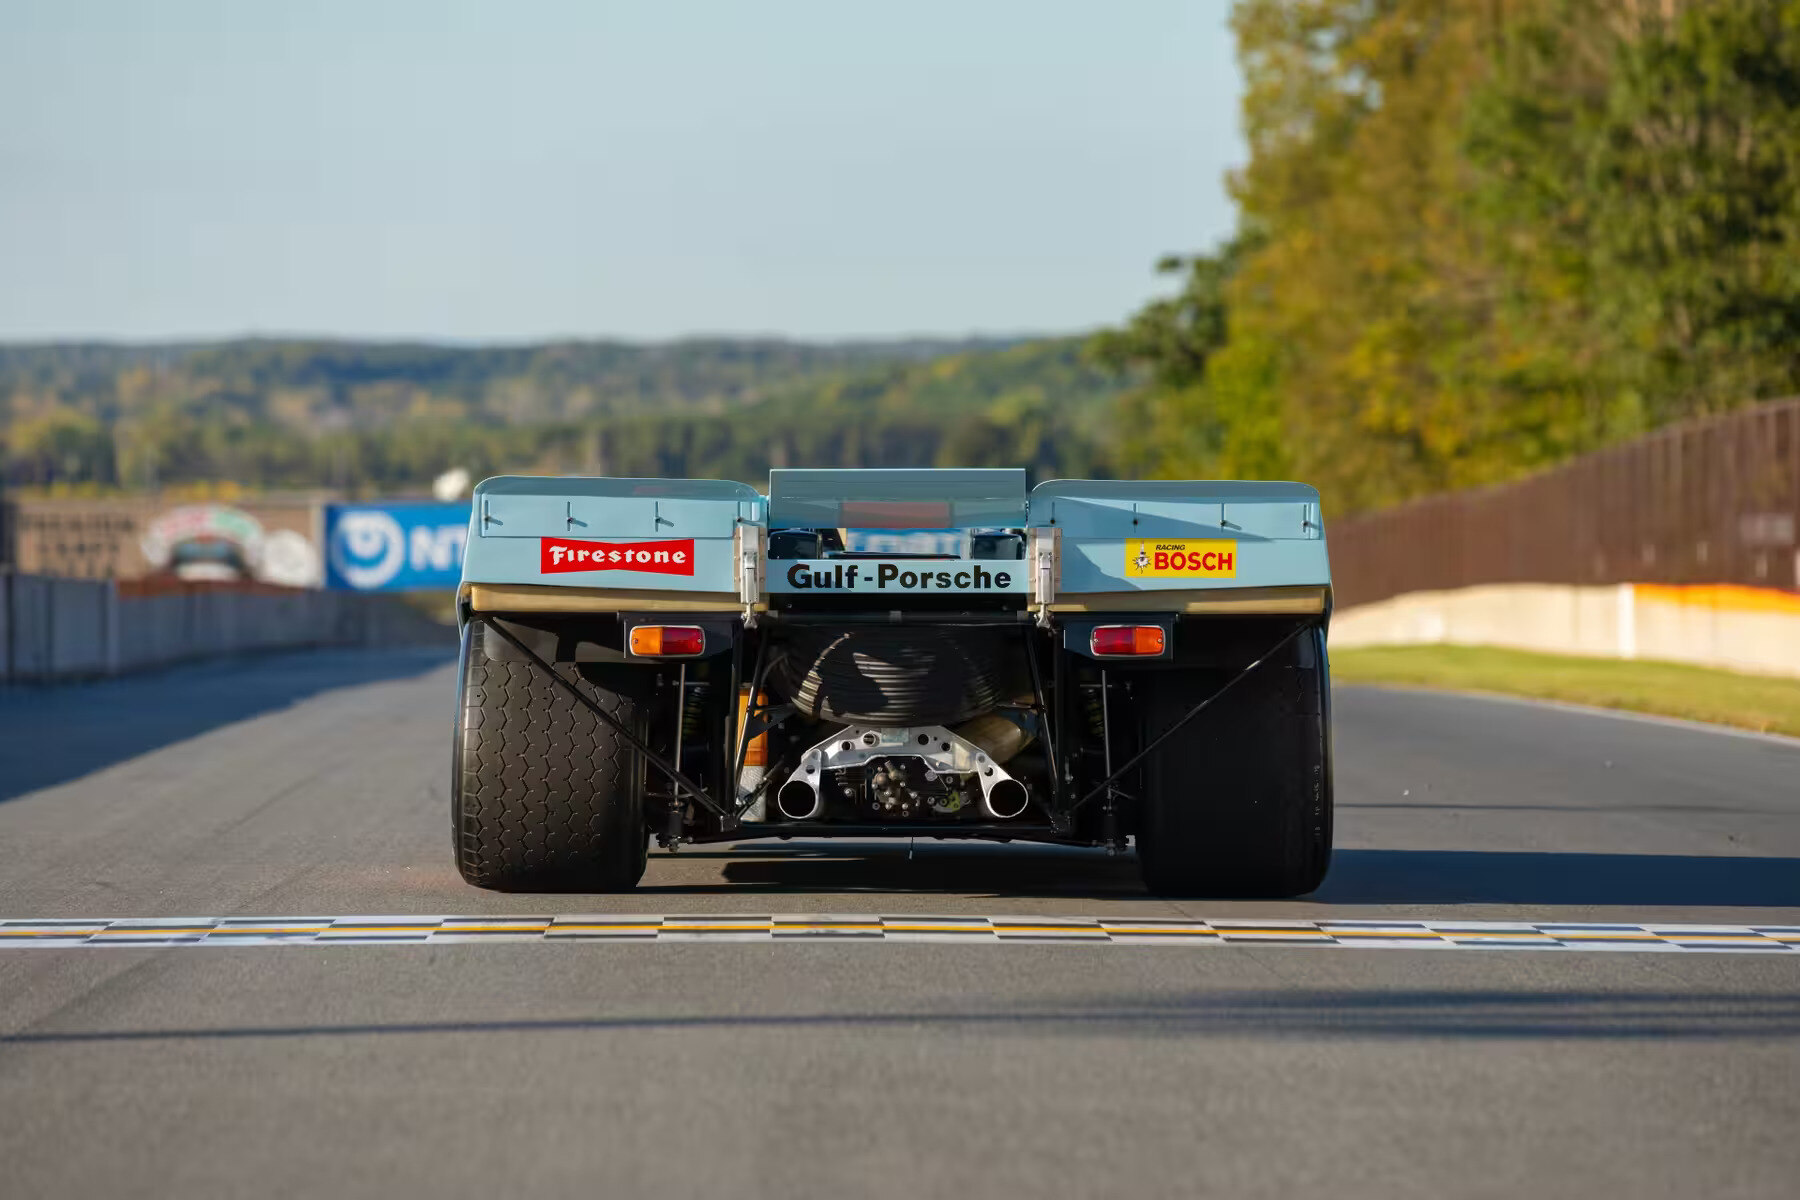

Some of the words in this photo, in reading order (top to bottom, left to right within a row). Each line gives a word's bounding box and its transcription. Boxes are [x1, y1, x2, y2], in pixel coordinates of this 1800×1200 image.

[548, 545, 686, 566] Firestone
[1154, 551, 1233, 571] BOSCH
[786, 563, 1012, 589] Gulf-Porsche
